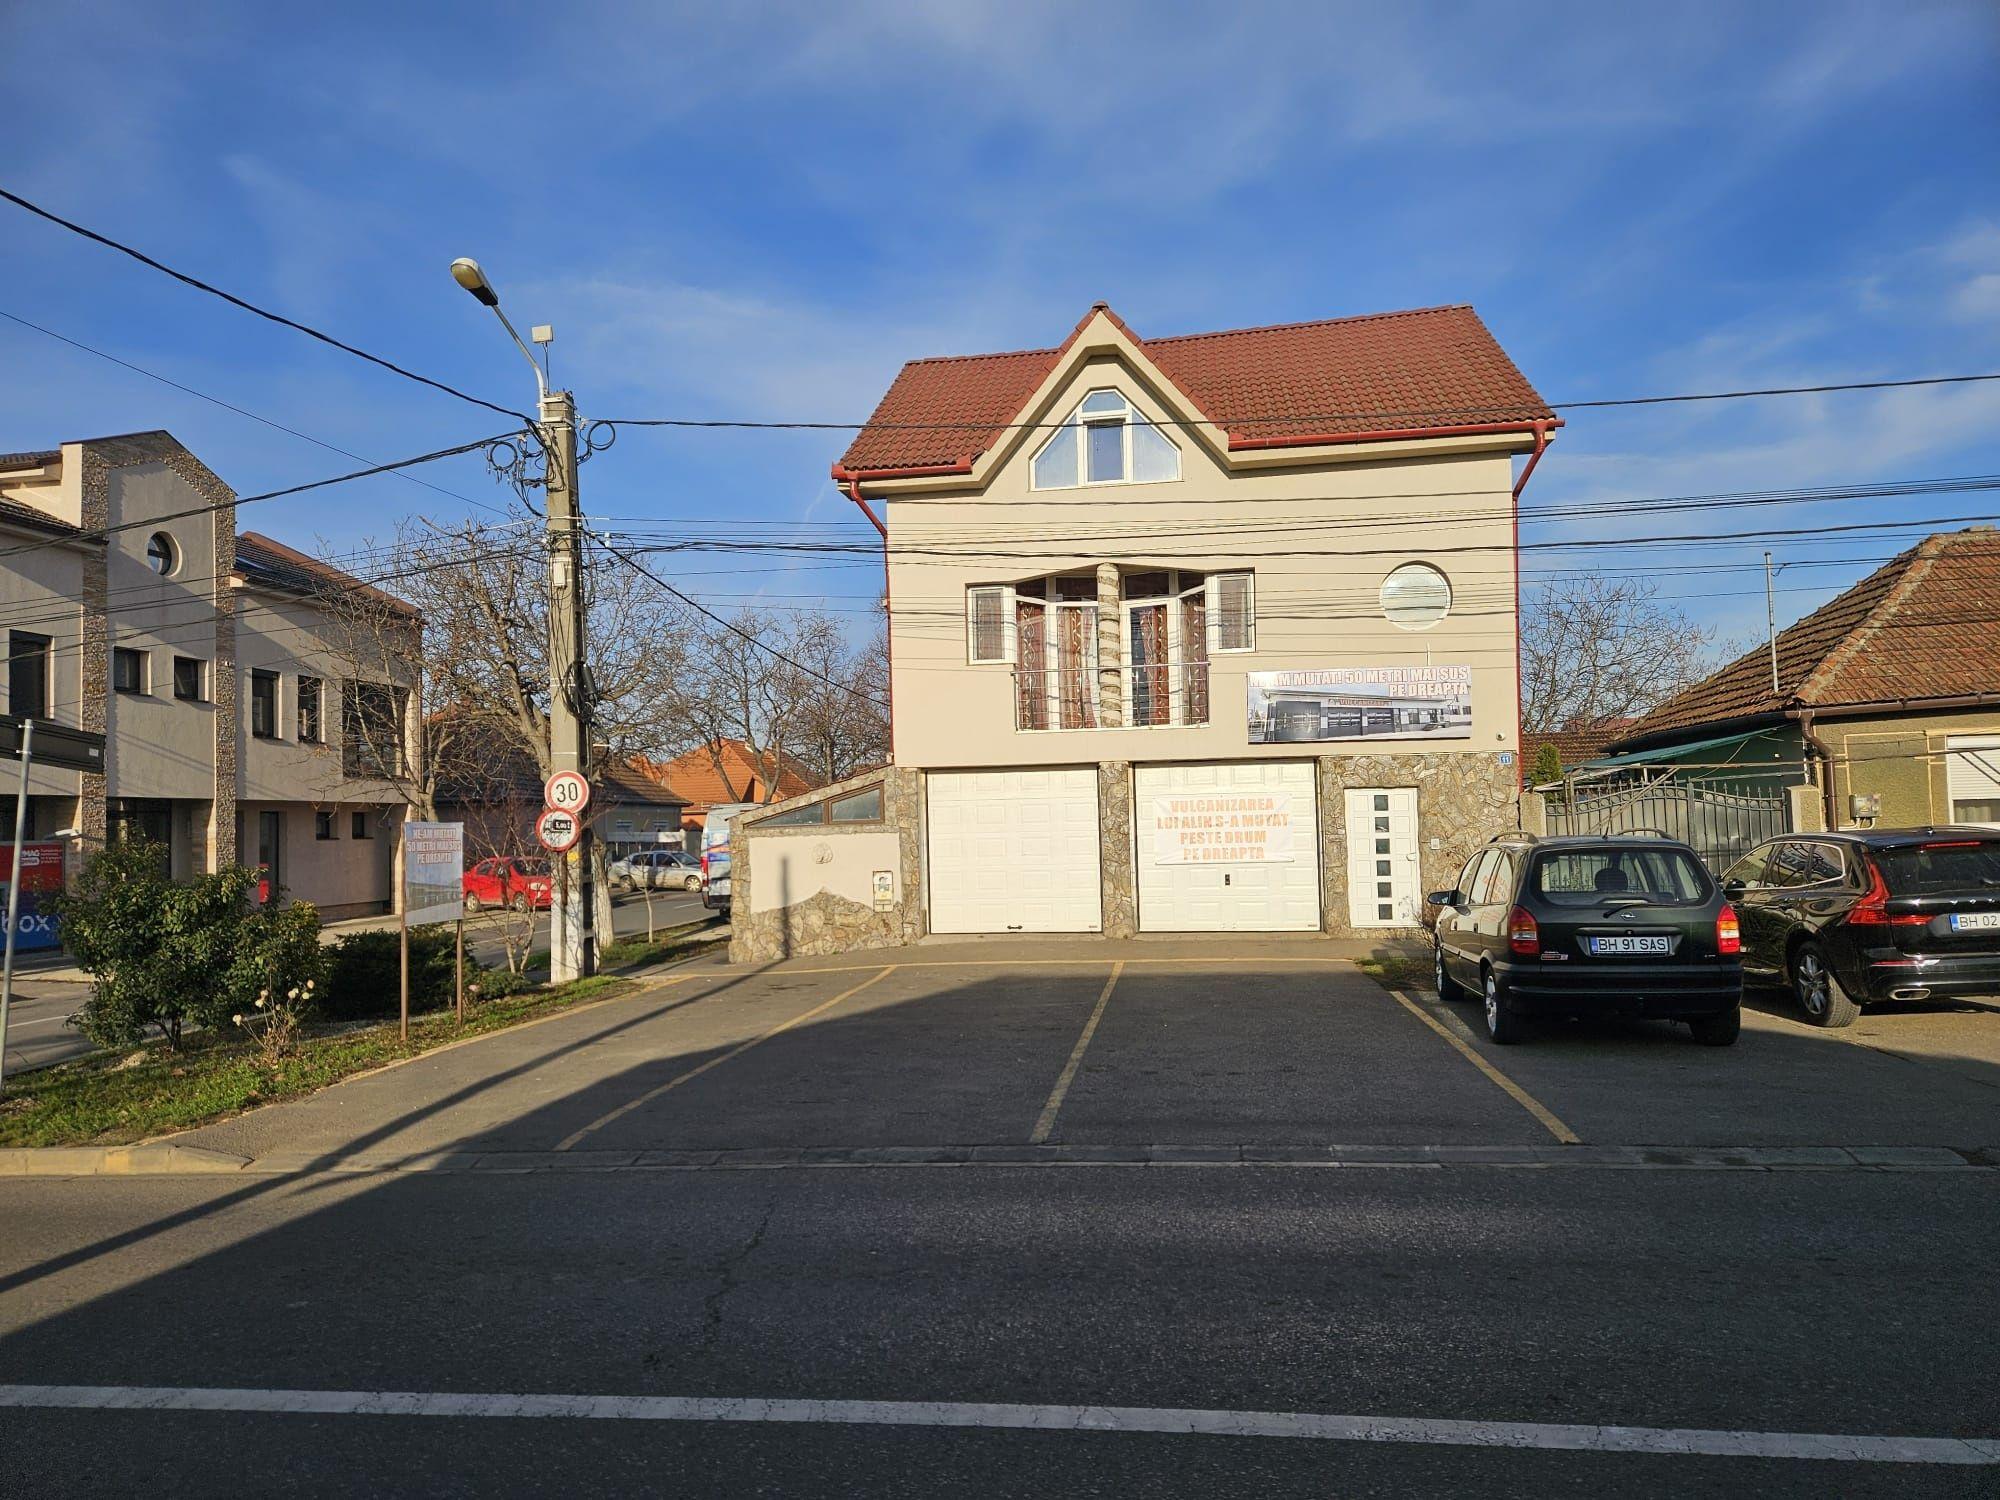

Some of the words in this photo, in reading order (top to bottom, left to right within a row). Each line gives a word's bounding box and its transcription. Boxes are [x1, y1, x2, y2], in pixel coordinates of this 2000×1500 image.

[1293, 670, 1342, 686] MUTAT!
[1345, 669, 1363, 684] 50
[1366, 668, 1408, 683] METRI
[1410, 667, 1438, 682] MAI
[1440, 666, 1468, 681] SUS
[1389, 683, 1406, 697] PE
[1408, 681, 1469, 697] DREAPTA
[556, 782, 578, 803] 30
[1170, 798, 1274, 813] VULCANIZAREA
[1157, 816, 1179, 829] LUI
[1215, 814, 1239, 828] S-A
[1242, 813, 1288, 827] MUTAT
[1180, 831, 1222, 845] PESTE
[1225, 830, 1266, 844] DRUM
[1184, 848, 1199, 860] PE
[1203, 846, 1265, 860] DREAPTA
[1960, 916, 1978, 927] BH
[1983, 915, 1998, 926] 02
[1599, 939, 1617, 950] BH
[1623, 939, 1635, 950] 91
[1640, 938, 1666, 950] SAS
